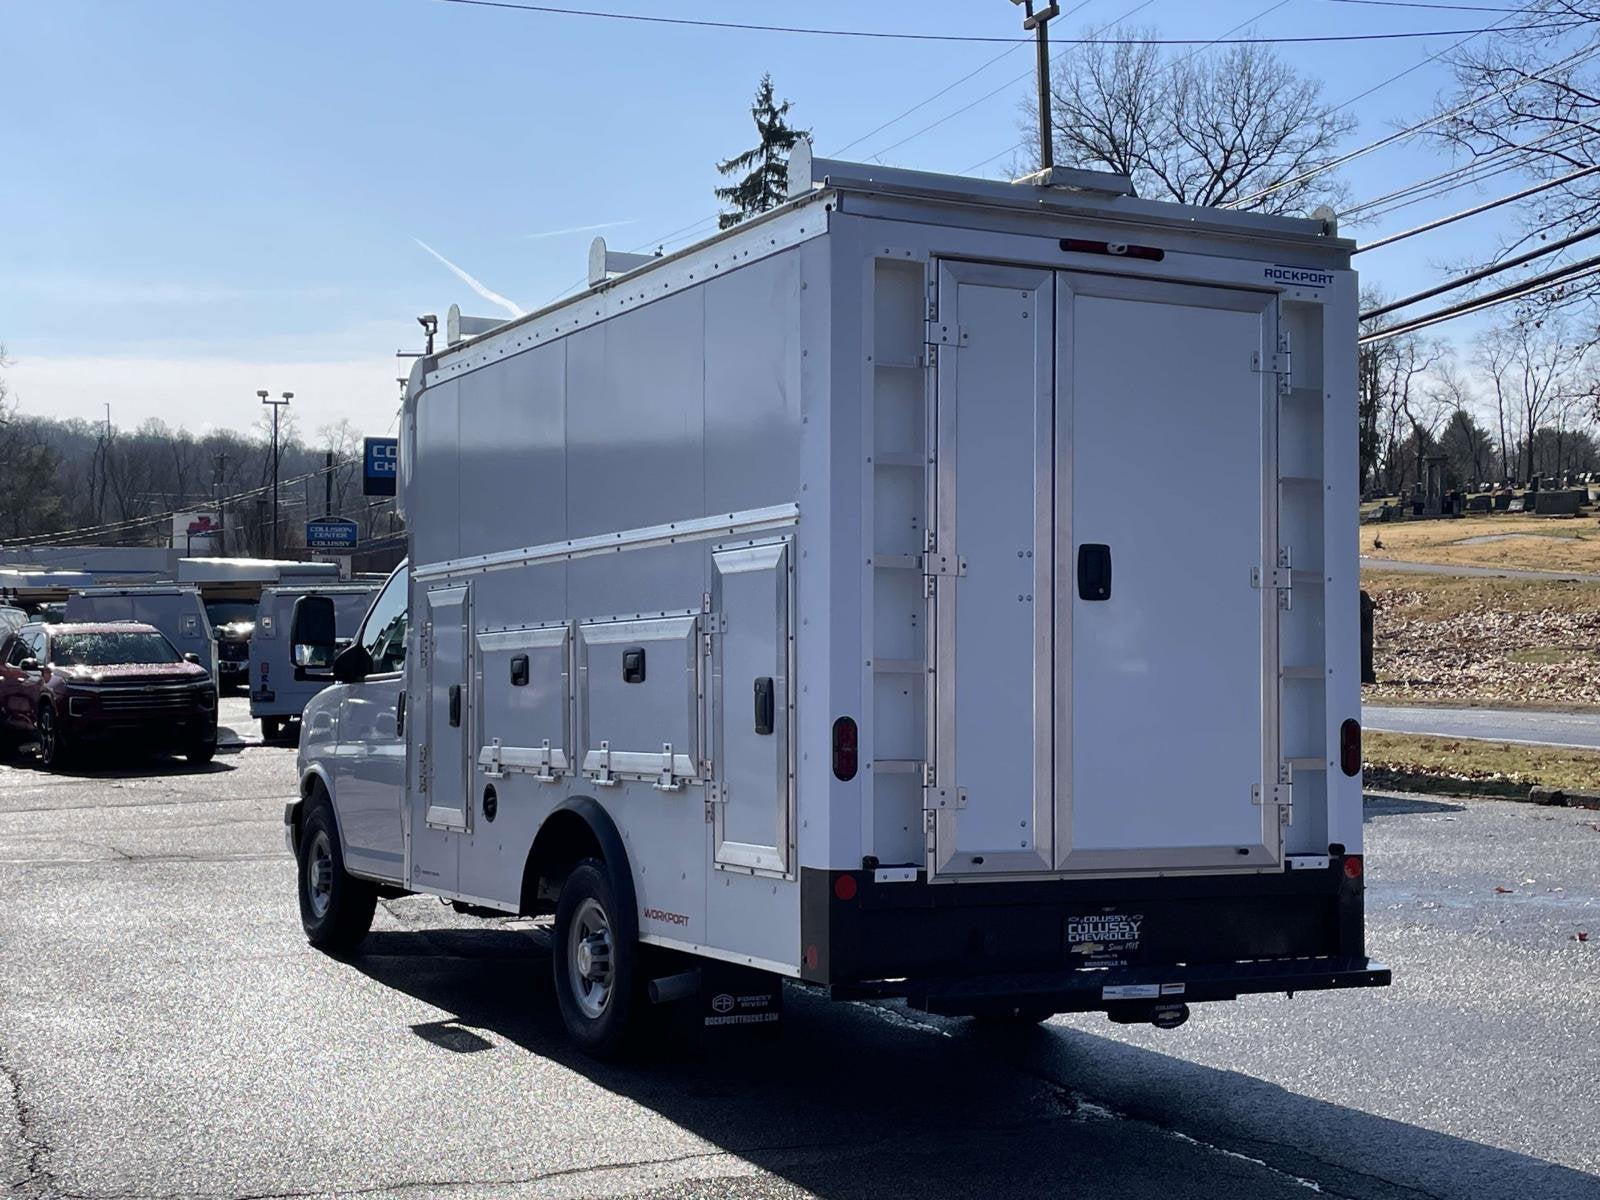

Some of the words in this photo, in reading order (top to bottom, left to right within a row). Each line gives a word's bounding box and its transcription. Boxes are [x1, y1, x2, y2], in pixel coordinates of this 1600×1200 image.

[1264, 268, 1335, 284] ROCKPORT
[644, 907, 689, 927] WORKPORT
[1083, 915, 1129, 923] COLUSSY
[1067, 921, 1142, 934] COLUSSY
[1067, 931, 1141, 942] CHEVROLET
